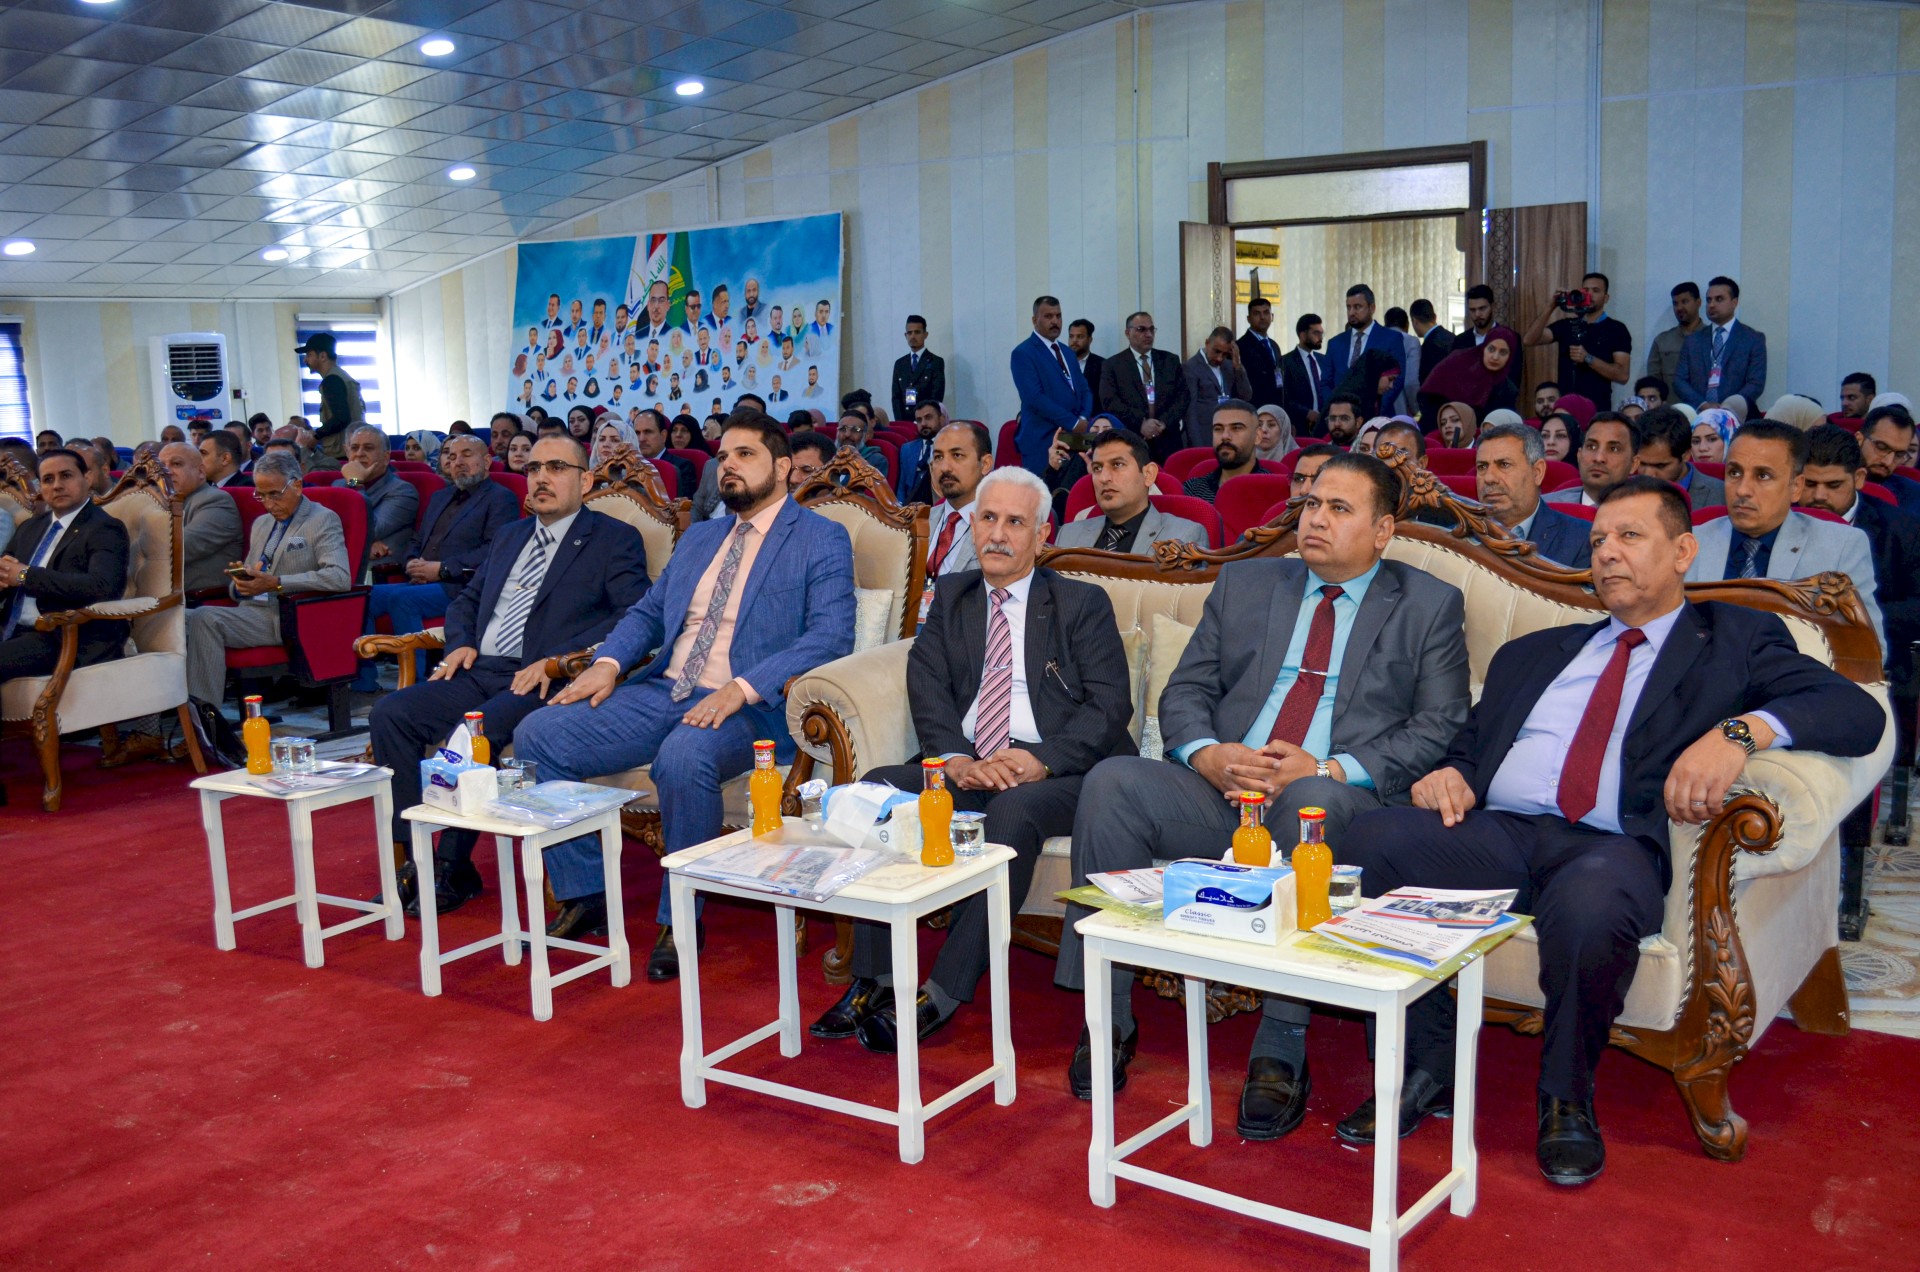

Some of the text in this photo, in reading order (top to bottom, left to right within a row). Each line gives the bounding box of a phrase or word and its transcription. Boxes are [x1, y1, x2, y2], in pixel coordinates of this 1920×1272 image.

[1197, 891, 1235, 903] كلاسيك
[1184, 908, 1212, 918] Classic
[1342, 923, 1372, 934] الدليل
[1372, 932, 1414, 947] الجامعي
